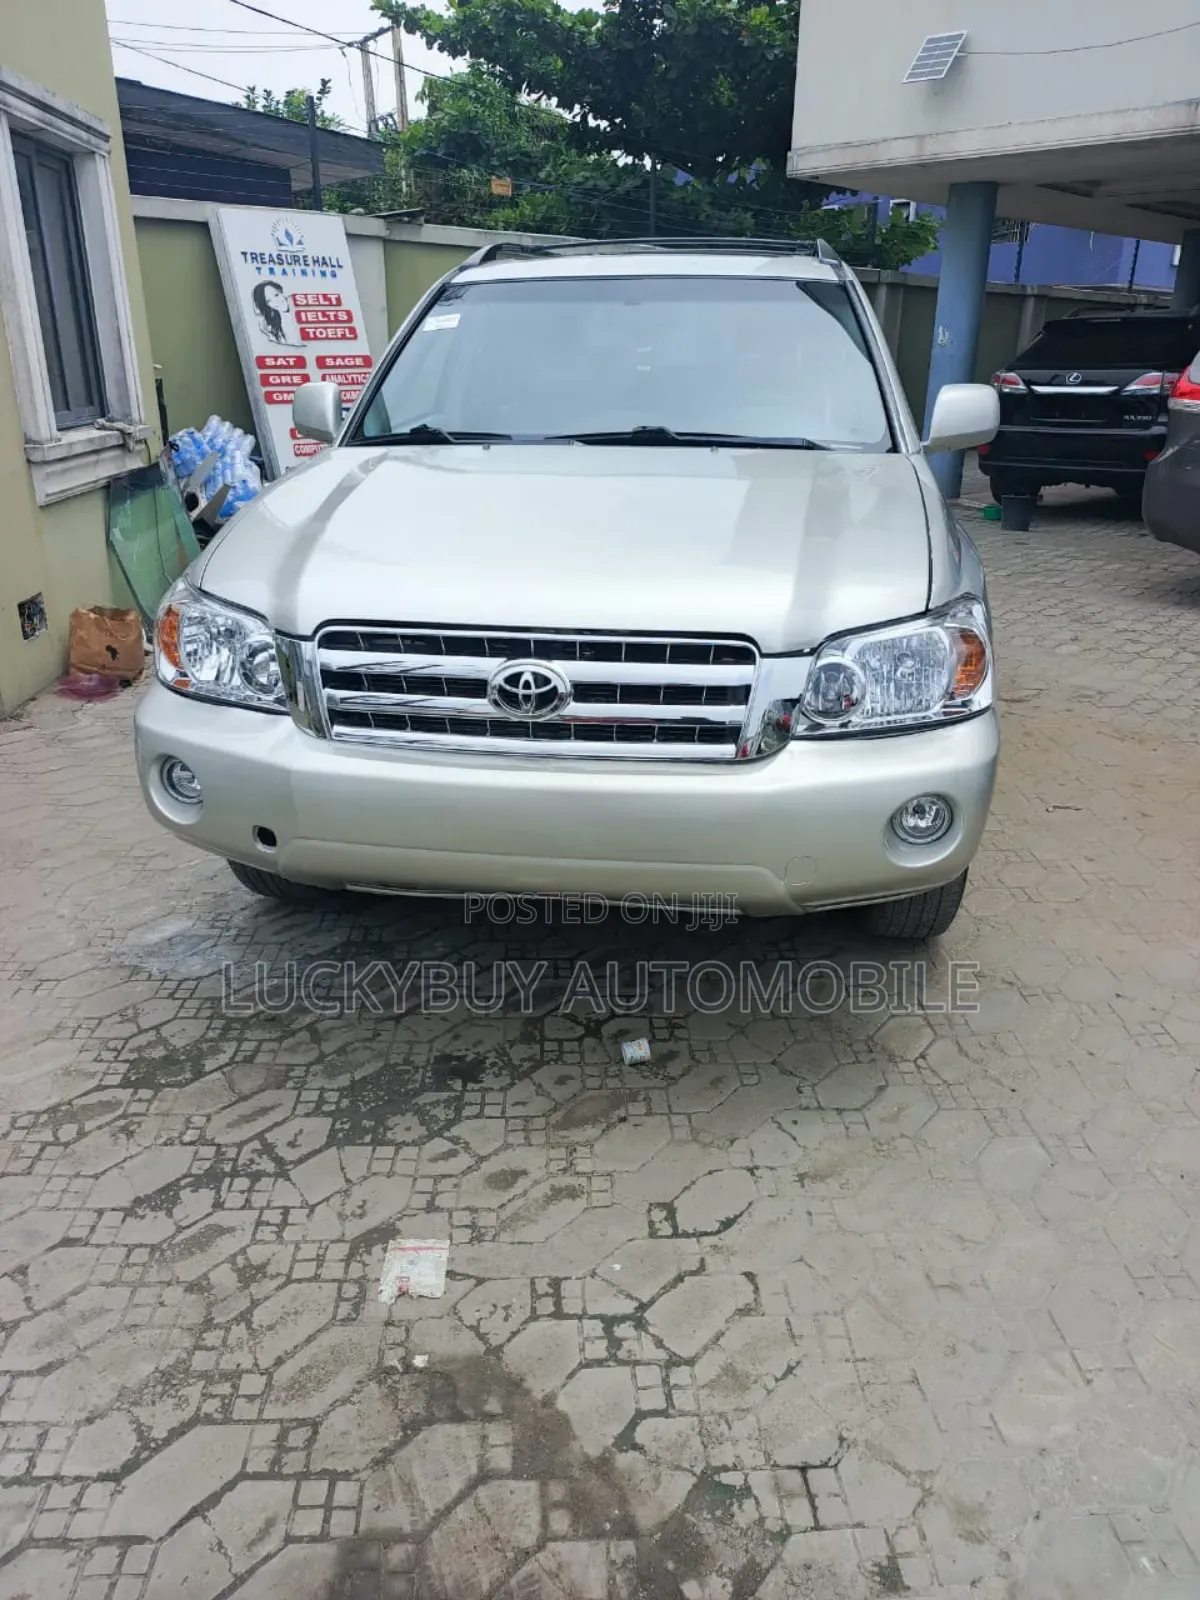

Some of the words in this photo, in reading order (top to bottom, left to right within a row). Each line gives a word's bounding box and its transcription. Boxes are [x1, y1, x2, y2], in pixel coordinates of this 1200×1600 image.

[241, 251, 310, 267] TREASURE
[312, 256, 344, 269] HALL
[255, 266, 338, 279] TRAINING
[294, 294, 339, 306] SELT
[300, 310, 348, 322] IELTS
[306, 328, 355, 338] TOEFL
[264, 357, 297, 366] SAT
[324, 357, 366, 366] SAGE
[268, 375, 303, 384] GRE
[272, 392, 295, 401] GM
